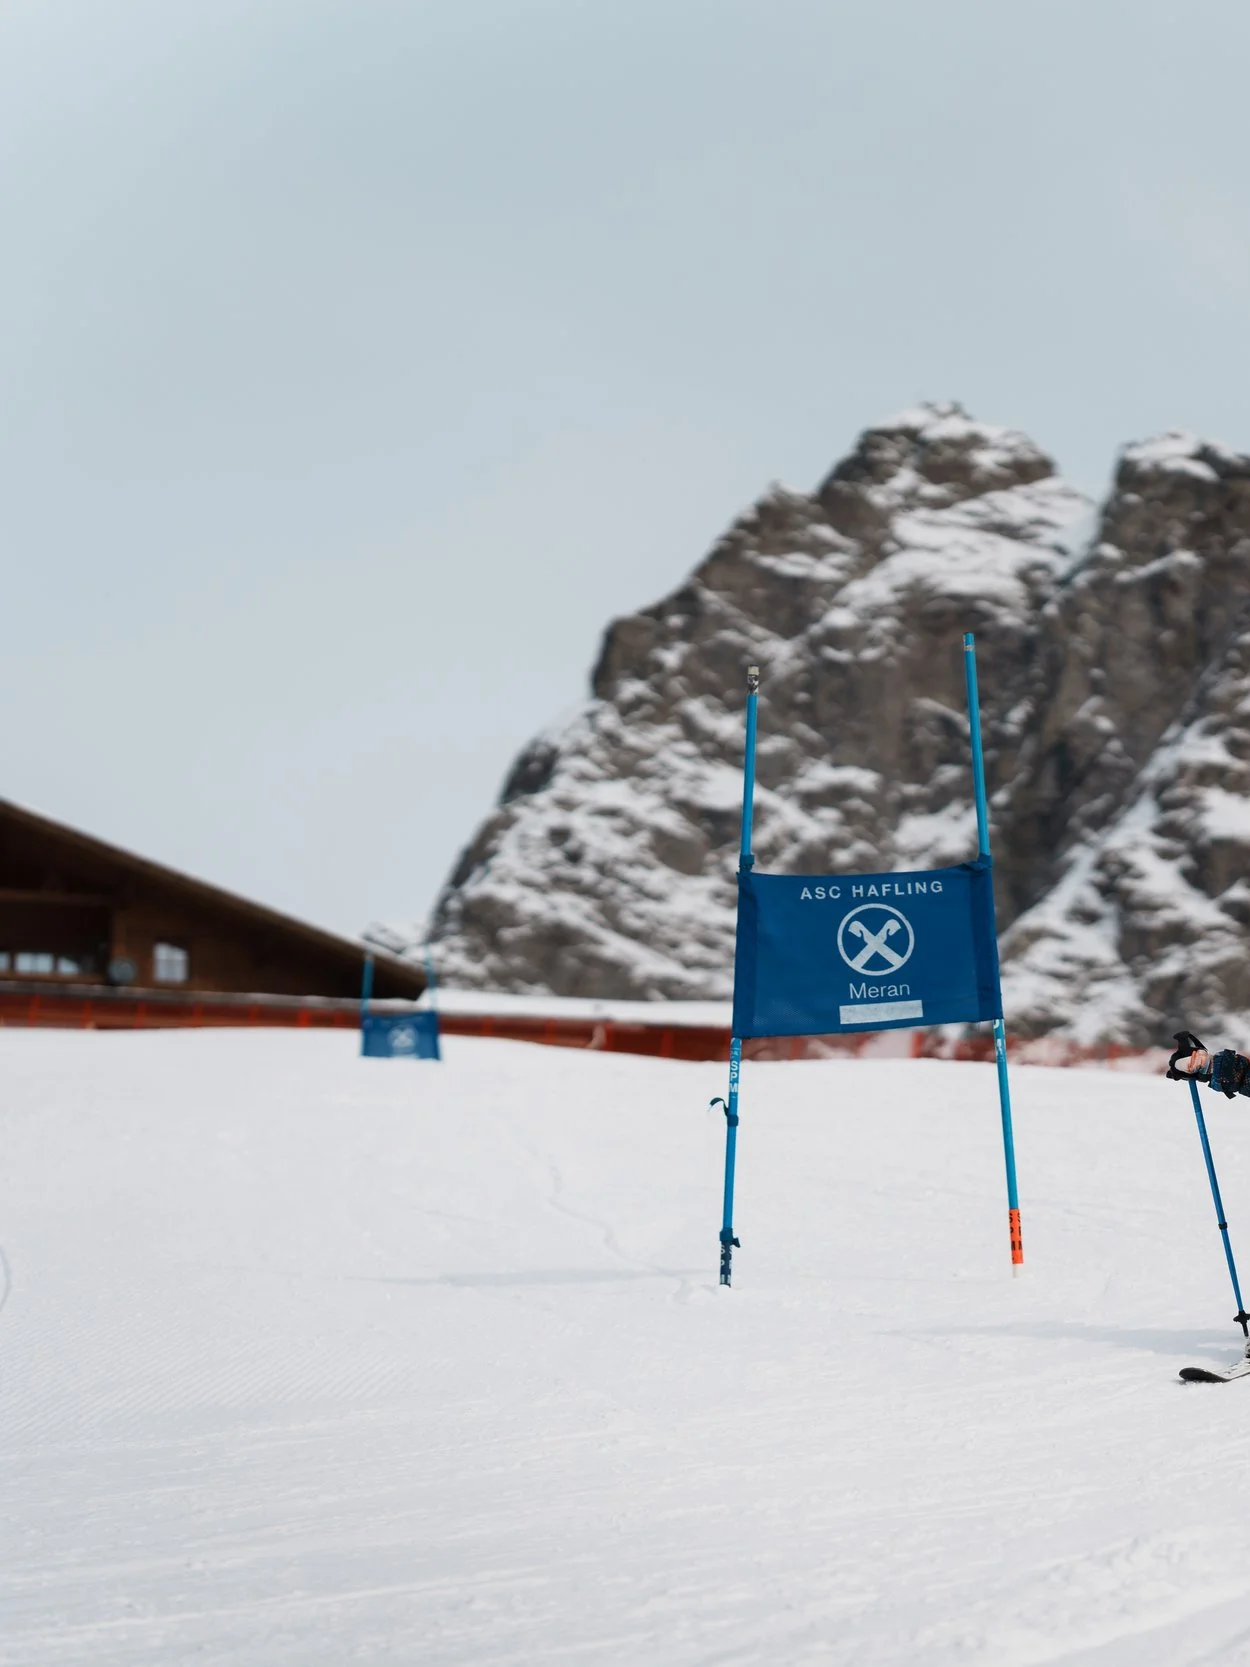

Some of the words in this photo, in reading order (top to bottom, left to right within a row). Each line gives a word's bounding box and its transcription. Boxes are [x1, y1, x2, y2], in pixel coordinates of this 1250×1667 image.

[800, 886, 841, 900] ASC
[852, 881, 943, 898] HAFLING
[849, 983, 910, 999] Meran
